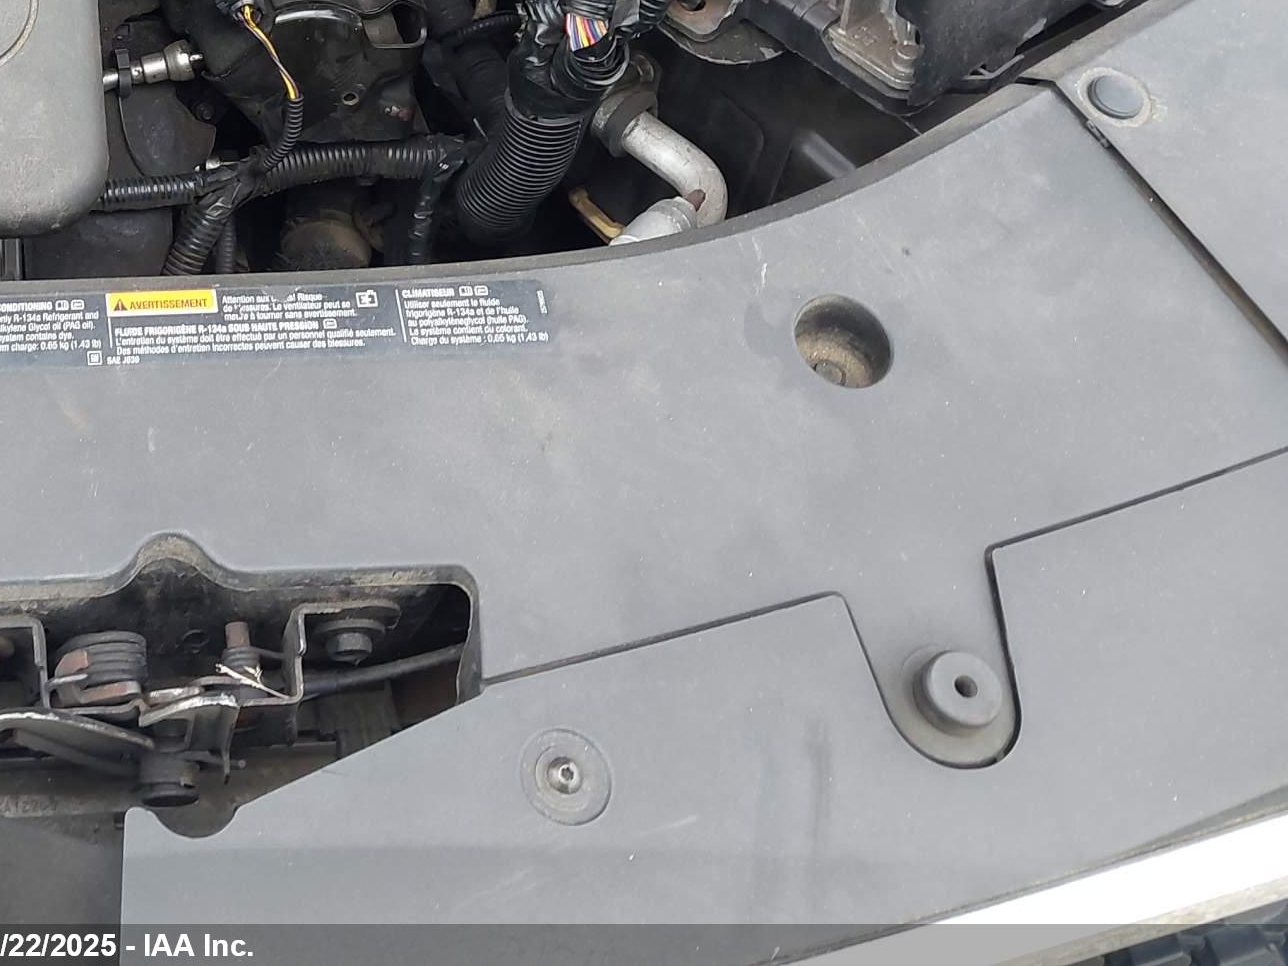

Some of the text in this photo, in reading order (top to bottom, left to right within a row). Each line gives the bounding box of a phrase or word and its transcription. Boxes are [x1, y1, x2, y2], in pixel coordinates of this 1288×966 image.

[222, 295, 254, 304] Attention
[297, 293, 322, 302] Risque
[402, 288, 454, 298] CLIMATISEUR
[130, 299, 207, 309] AVERTISSEMENT
[283, 301, 321, 310] ventilateur
[324, 301, 340, 309] peut
[404, 298, 500, 309] Utiliser seulement le fluide
[256, 312, 283, 320] tourner
[447, 308, 474, 316] R-134a
[486, 307, 495, 315] de
[497, 306, 519, 314] l'huile
[13, 314, 40, 322] R-134a
[43, 312, 83, 323] Refrigerant
[85, 311, 98, 320] and
[28, 323, 50, 332] Glycol
[52, 322, 61, 330] oil
[63, 322, 80, 331] (PAG
[115, 327, 143, 336] FLUIDE
[198, 324, 227, 334] R-134a
[228, 323, 250, 332] SOUS
[251, 322, 277, 331] HAUTE
[279, 321, 318, 330] PRESSION
[410, 328, 419, 336] Le
[421, 326, 451, 336] système
[453, 325, 483, 333] contient
[485, 325, 494, 333] du
[26, 332, 57, 341] contains
[59, 332, 74, 340] dye.
[156, 336, 165, 344] du
[167, 335, 198, 345] système
[200, 334, 214, 343] doit
[216, 333, 230, 342] être
[263, 333, 276, 342] par
[289, 331, 325, 340] personnel
[327, 329, 353, 339] qualifié
[356, 328, 396, 337] seulement.
[411, 337, 437, 346] Charge
[440, 336, 449, 345] du
[451, 335, 481, 346] système
[506, 334, 516, 343] kg
[539, 332, 548, 342] lb)
[11, 343, 39, 352] charge:
[40, 342, 58, 350] 0.65
[59, 341, 69, 350] kg
[92, 339, 101, 349] lb)
[116, 347, 131, 355] Des
[133, 345, 169, 354] méthodes
[255, 342, 284, 351] peuvent
[286, 341, 311, 349] causer
[313, 340, 326, 348] des
[328, 339, 365, 347] blessures.
